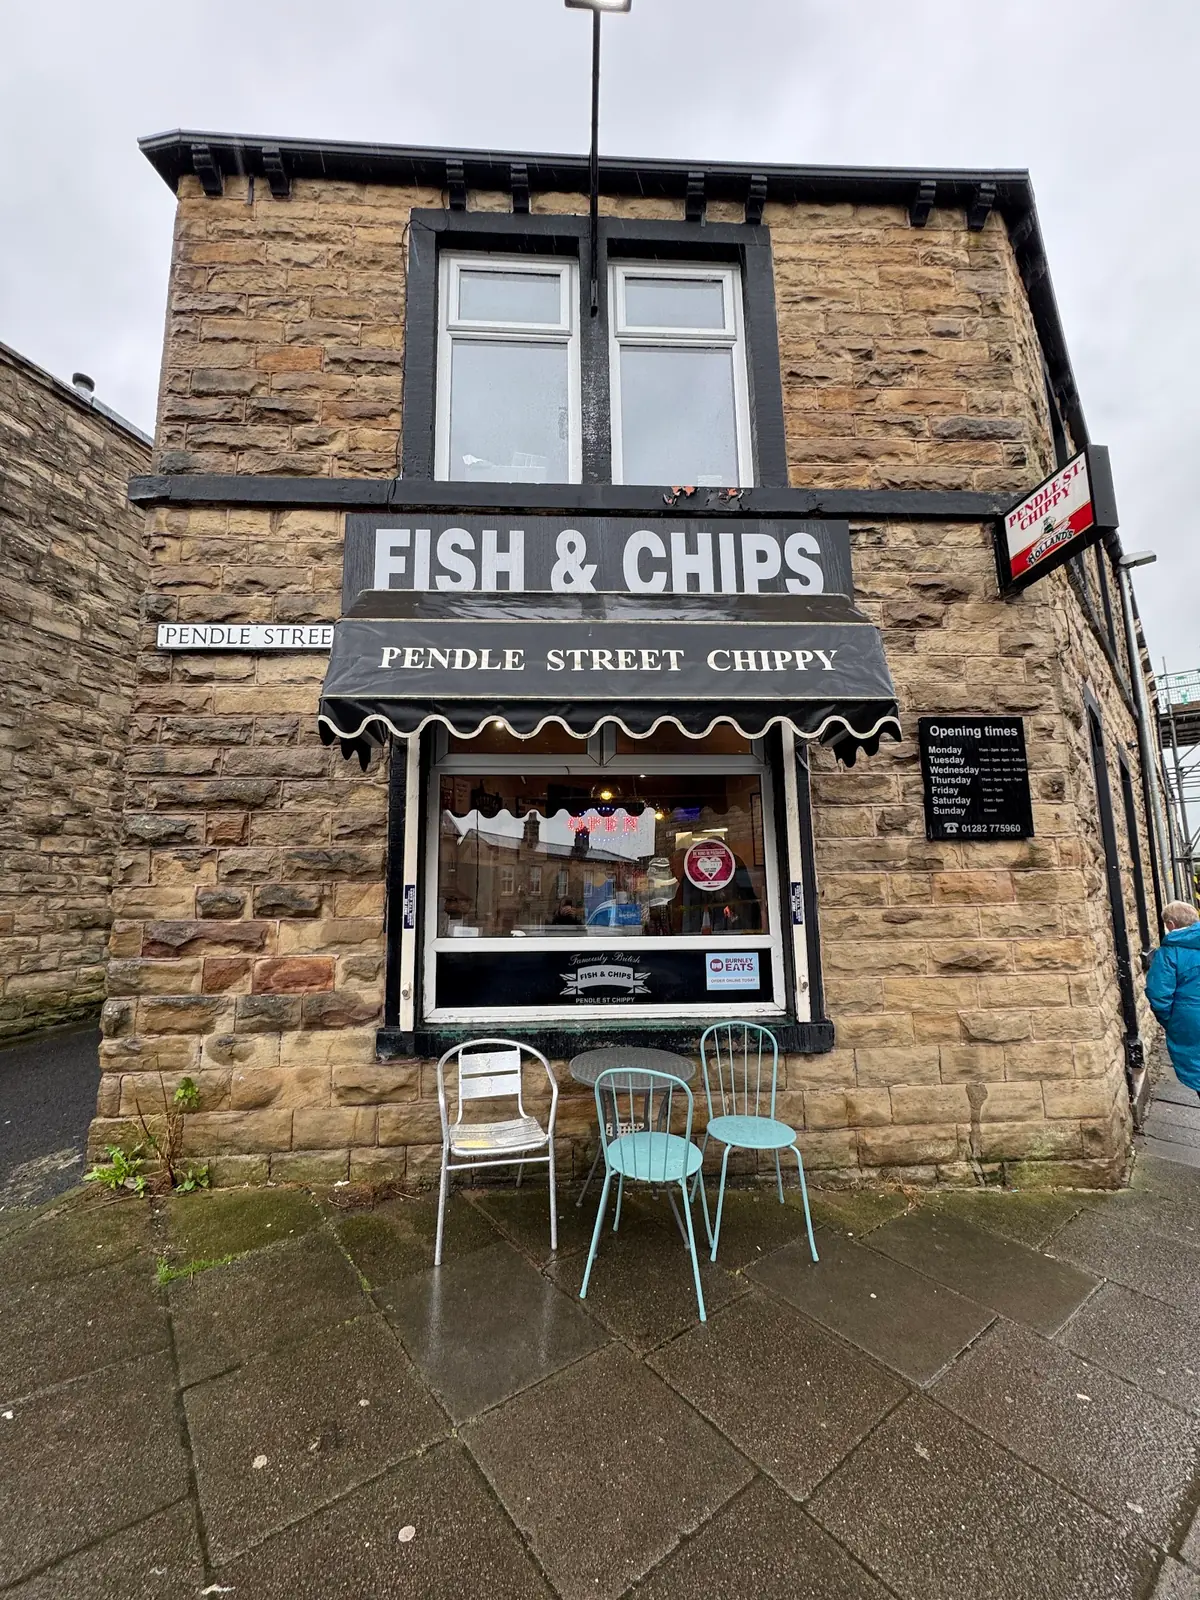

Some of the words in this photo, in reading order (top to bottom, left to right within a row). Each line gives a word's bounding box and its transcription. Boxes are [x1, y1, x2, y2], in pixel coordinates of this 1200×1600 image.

[1008, 479, 1061, 528] PENDLE
[1020, 483, 1072, 531] CHIPPY
[374, 527, 524, 592] FISH
[550, 529, 598, 594] &
[622, 530, 825, 596] CHIPS
[165, 627, 250, 644] PENDLE
[264, 628, 332, 645] STREE
[377, 646, 526, 671] PENDLE
[546, 648, 685, 671] STREET
[706, 649, 838, 673] CHIPPY
[929, 725, 982, 739] Opening
[984, 726, 1018, 737] times
[928, 746, 962, 756] Monday
[929, 756, 965, 766] Tuesday
[930, 766, 980, 776] Wednesday
[930, 776, 972, 786] Thursday
[932, 787, 959, 796] Friday
[932, 797, 972, 806] Saturday
[933, 807, 966, 817] Sunday
[567, 816, 639, 832] OPEN
[961, 824, 988, 833] 01282
[990, 824, 1021, 833] 775960
[568, 953, 608, 967] Famously
[611, 951, 641, 964] British
[725, 963, 754, 972] EATS
[580, 972, 598, 981] FISH
[607, 971, 632, 980] CHIPS
[575, 996, 600, 1004] PENDLE
[611, 996, 636, 1004] CHIPPY
